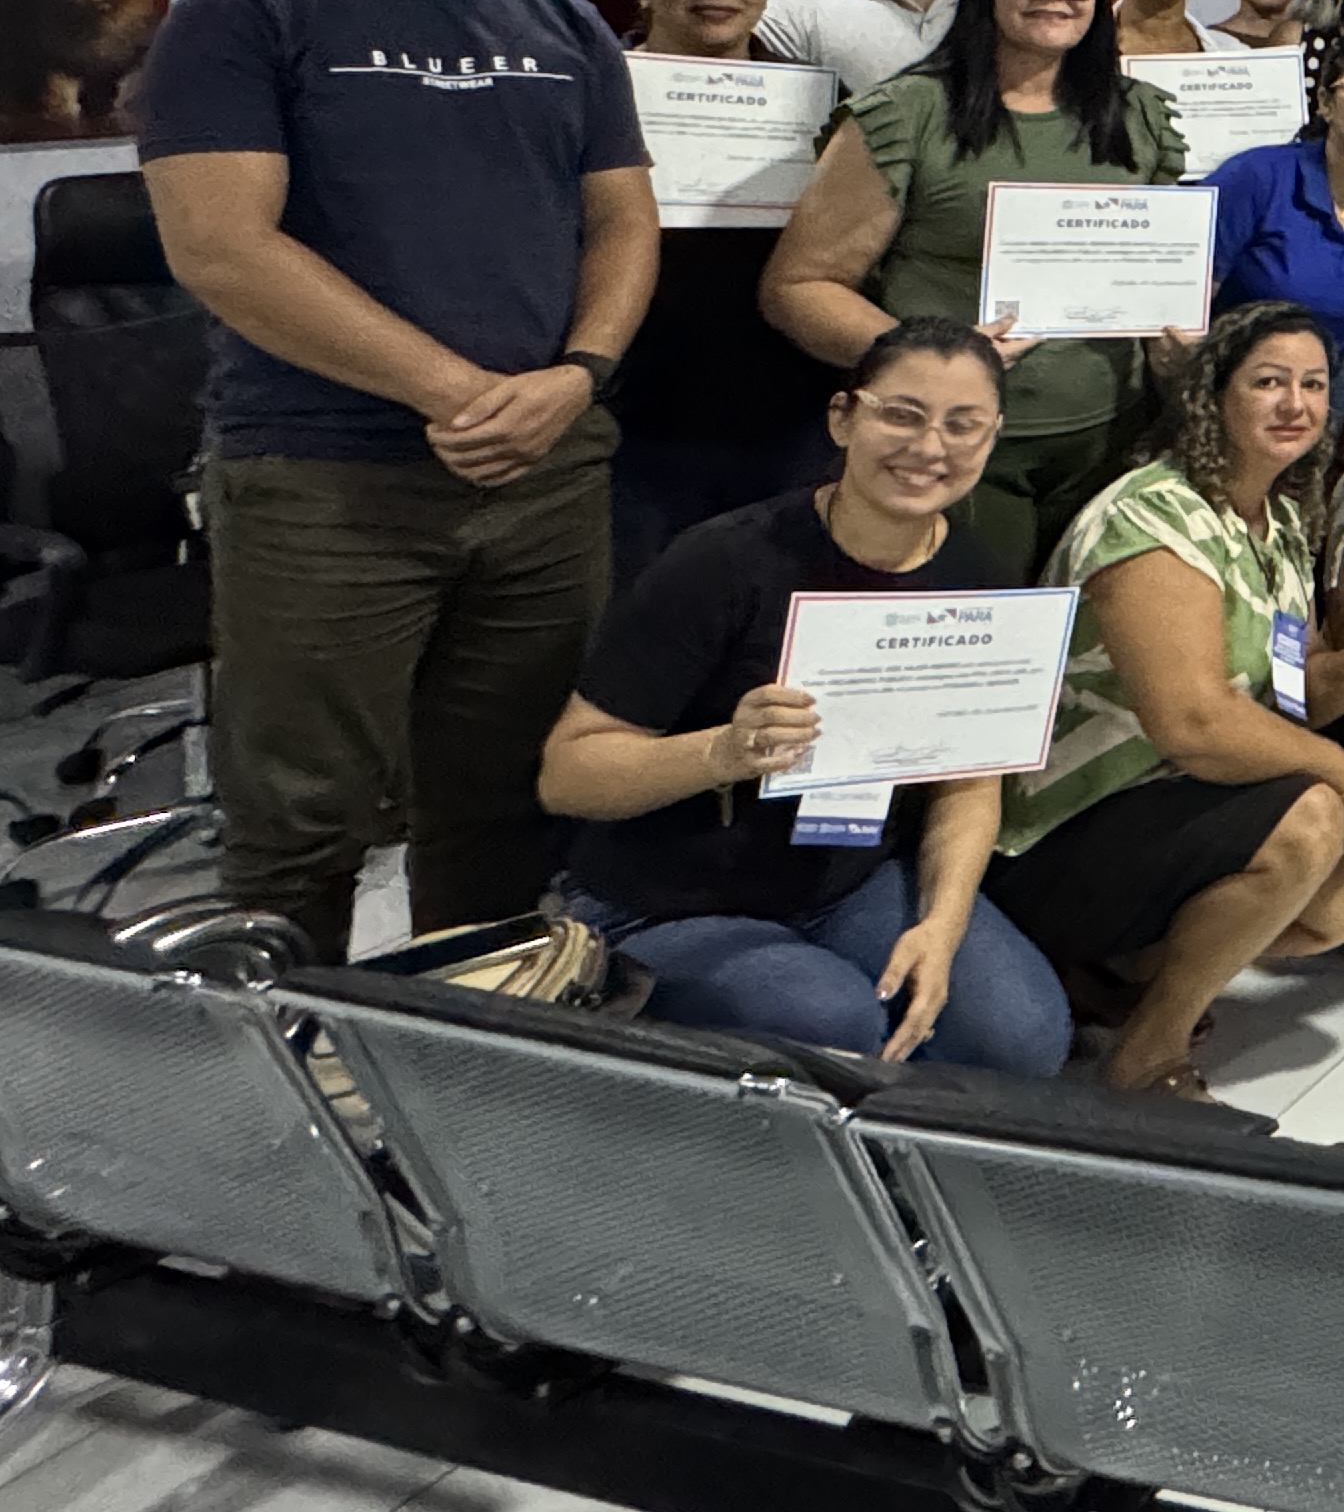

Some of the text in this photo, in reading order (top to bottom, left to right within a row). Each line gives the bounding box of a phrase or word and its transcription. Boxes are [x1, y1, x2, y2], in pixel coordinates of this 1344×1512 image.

[371, 50, 538, 74] BLUEER
[1180, 82, 1253, 92] CERTIFICADO
[666, 91, 768, 106] CERTIFICADO
[1056, 218, 1151, 230] CERTIFICADO
[876, 634, 993, 650] CERTIFICADO
